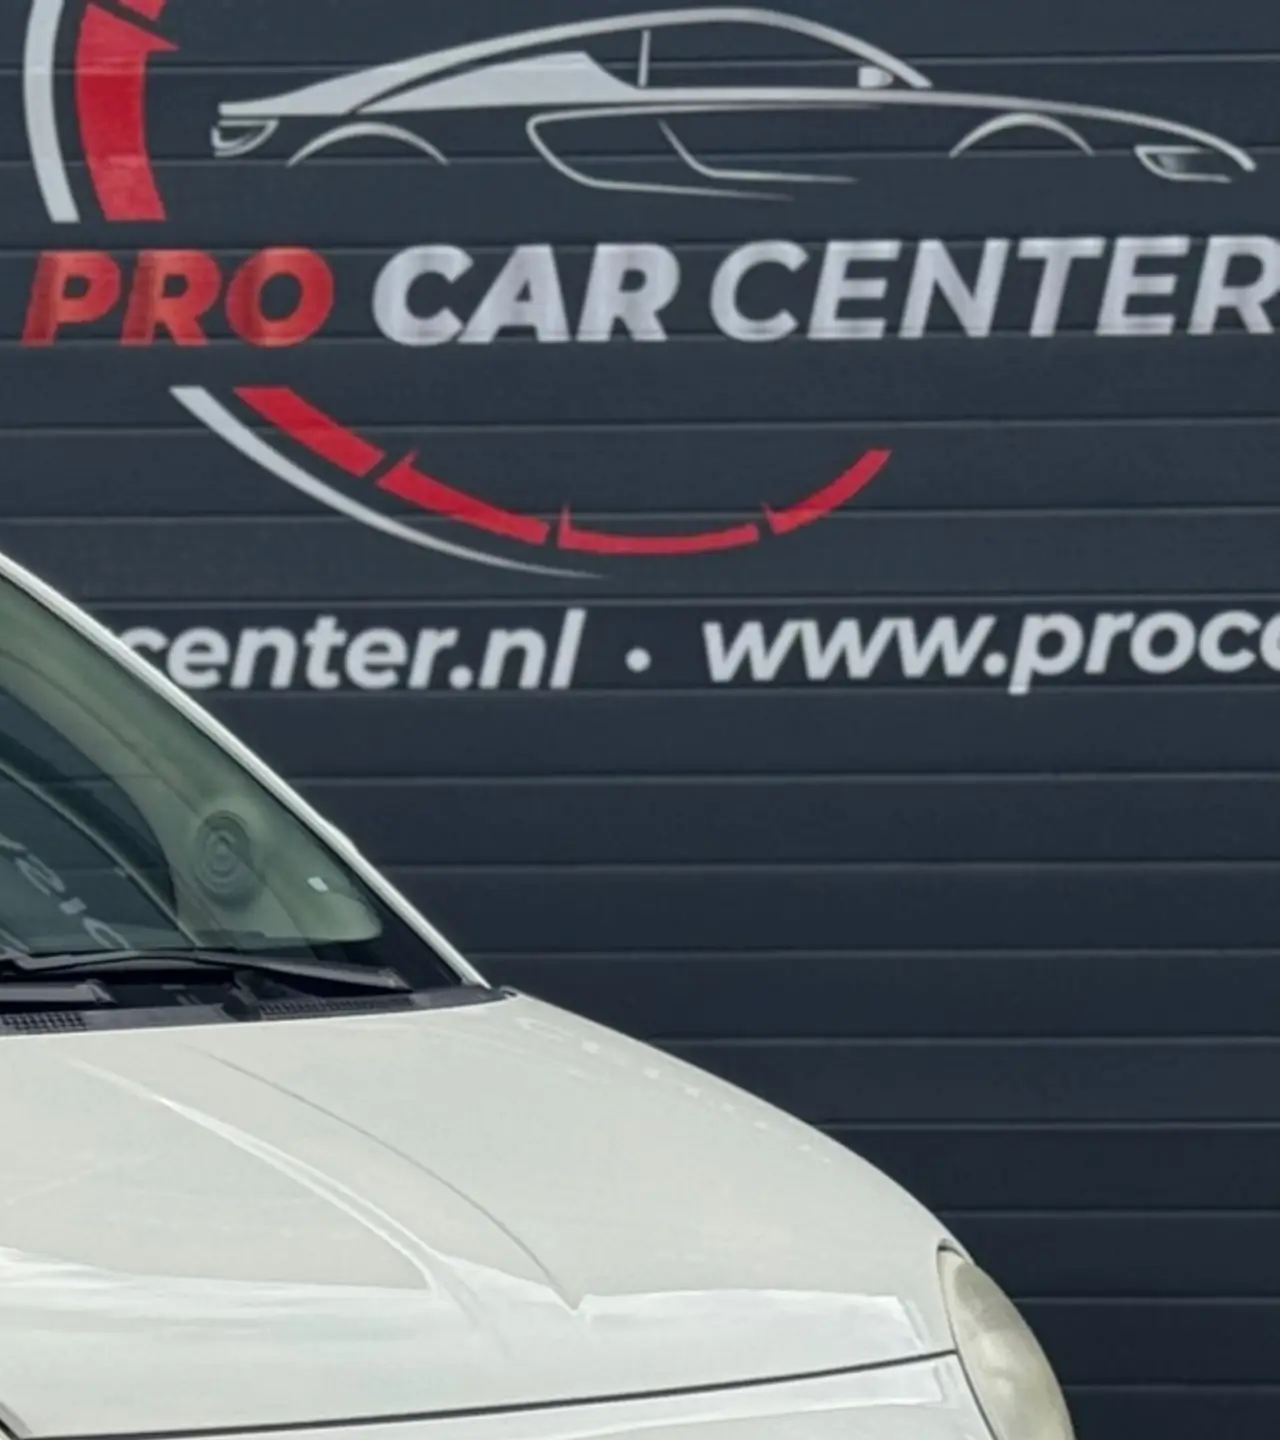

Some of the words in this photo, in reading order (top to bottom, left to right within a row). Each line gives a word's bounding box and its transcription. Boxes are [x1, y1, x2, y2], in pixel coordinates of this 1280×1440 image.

[23, 245, 334, 348] PRO
[373, 243, 681, 346] CAR
[710, 235, 1280, 342] CENTER
